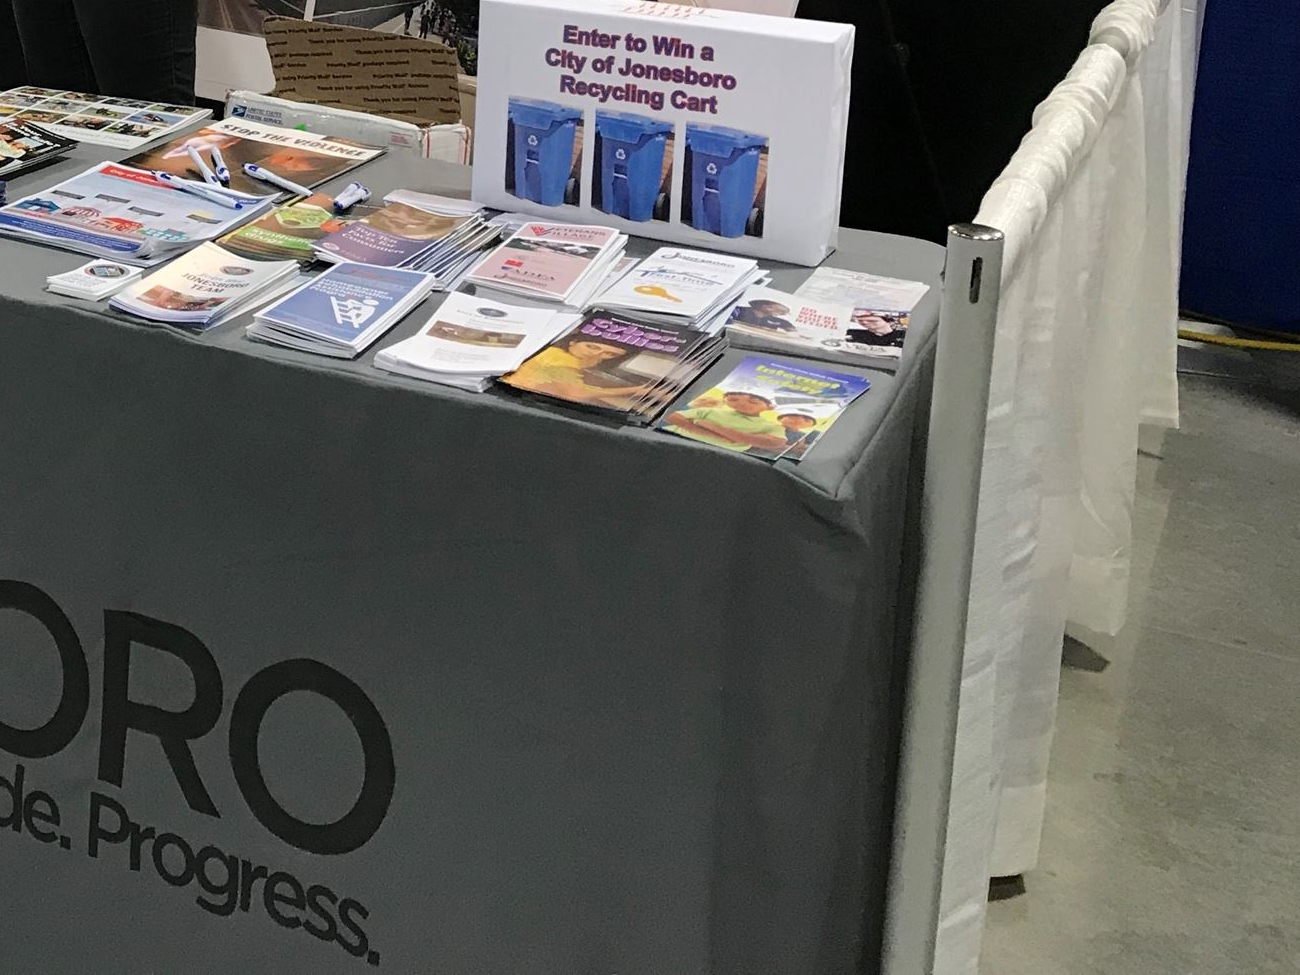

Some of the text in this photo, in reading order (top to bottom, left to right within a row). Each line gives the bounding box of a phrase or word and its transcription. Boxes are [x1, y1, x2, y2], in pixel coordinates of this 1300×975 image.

[562, 23, 715, 62] Enter to Win a
[544, 48, 737, 91] City of Jonesboro
[559, 73, 718, 115] Recycling Cart
[220, 123, 366, 158] STOP THE VIOLENCE
[181, 272, 250, 289] JONESBORO
[190, 282, 225, 294] TEAM
[86, 791, 384, 967] Progress.
